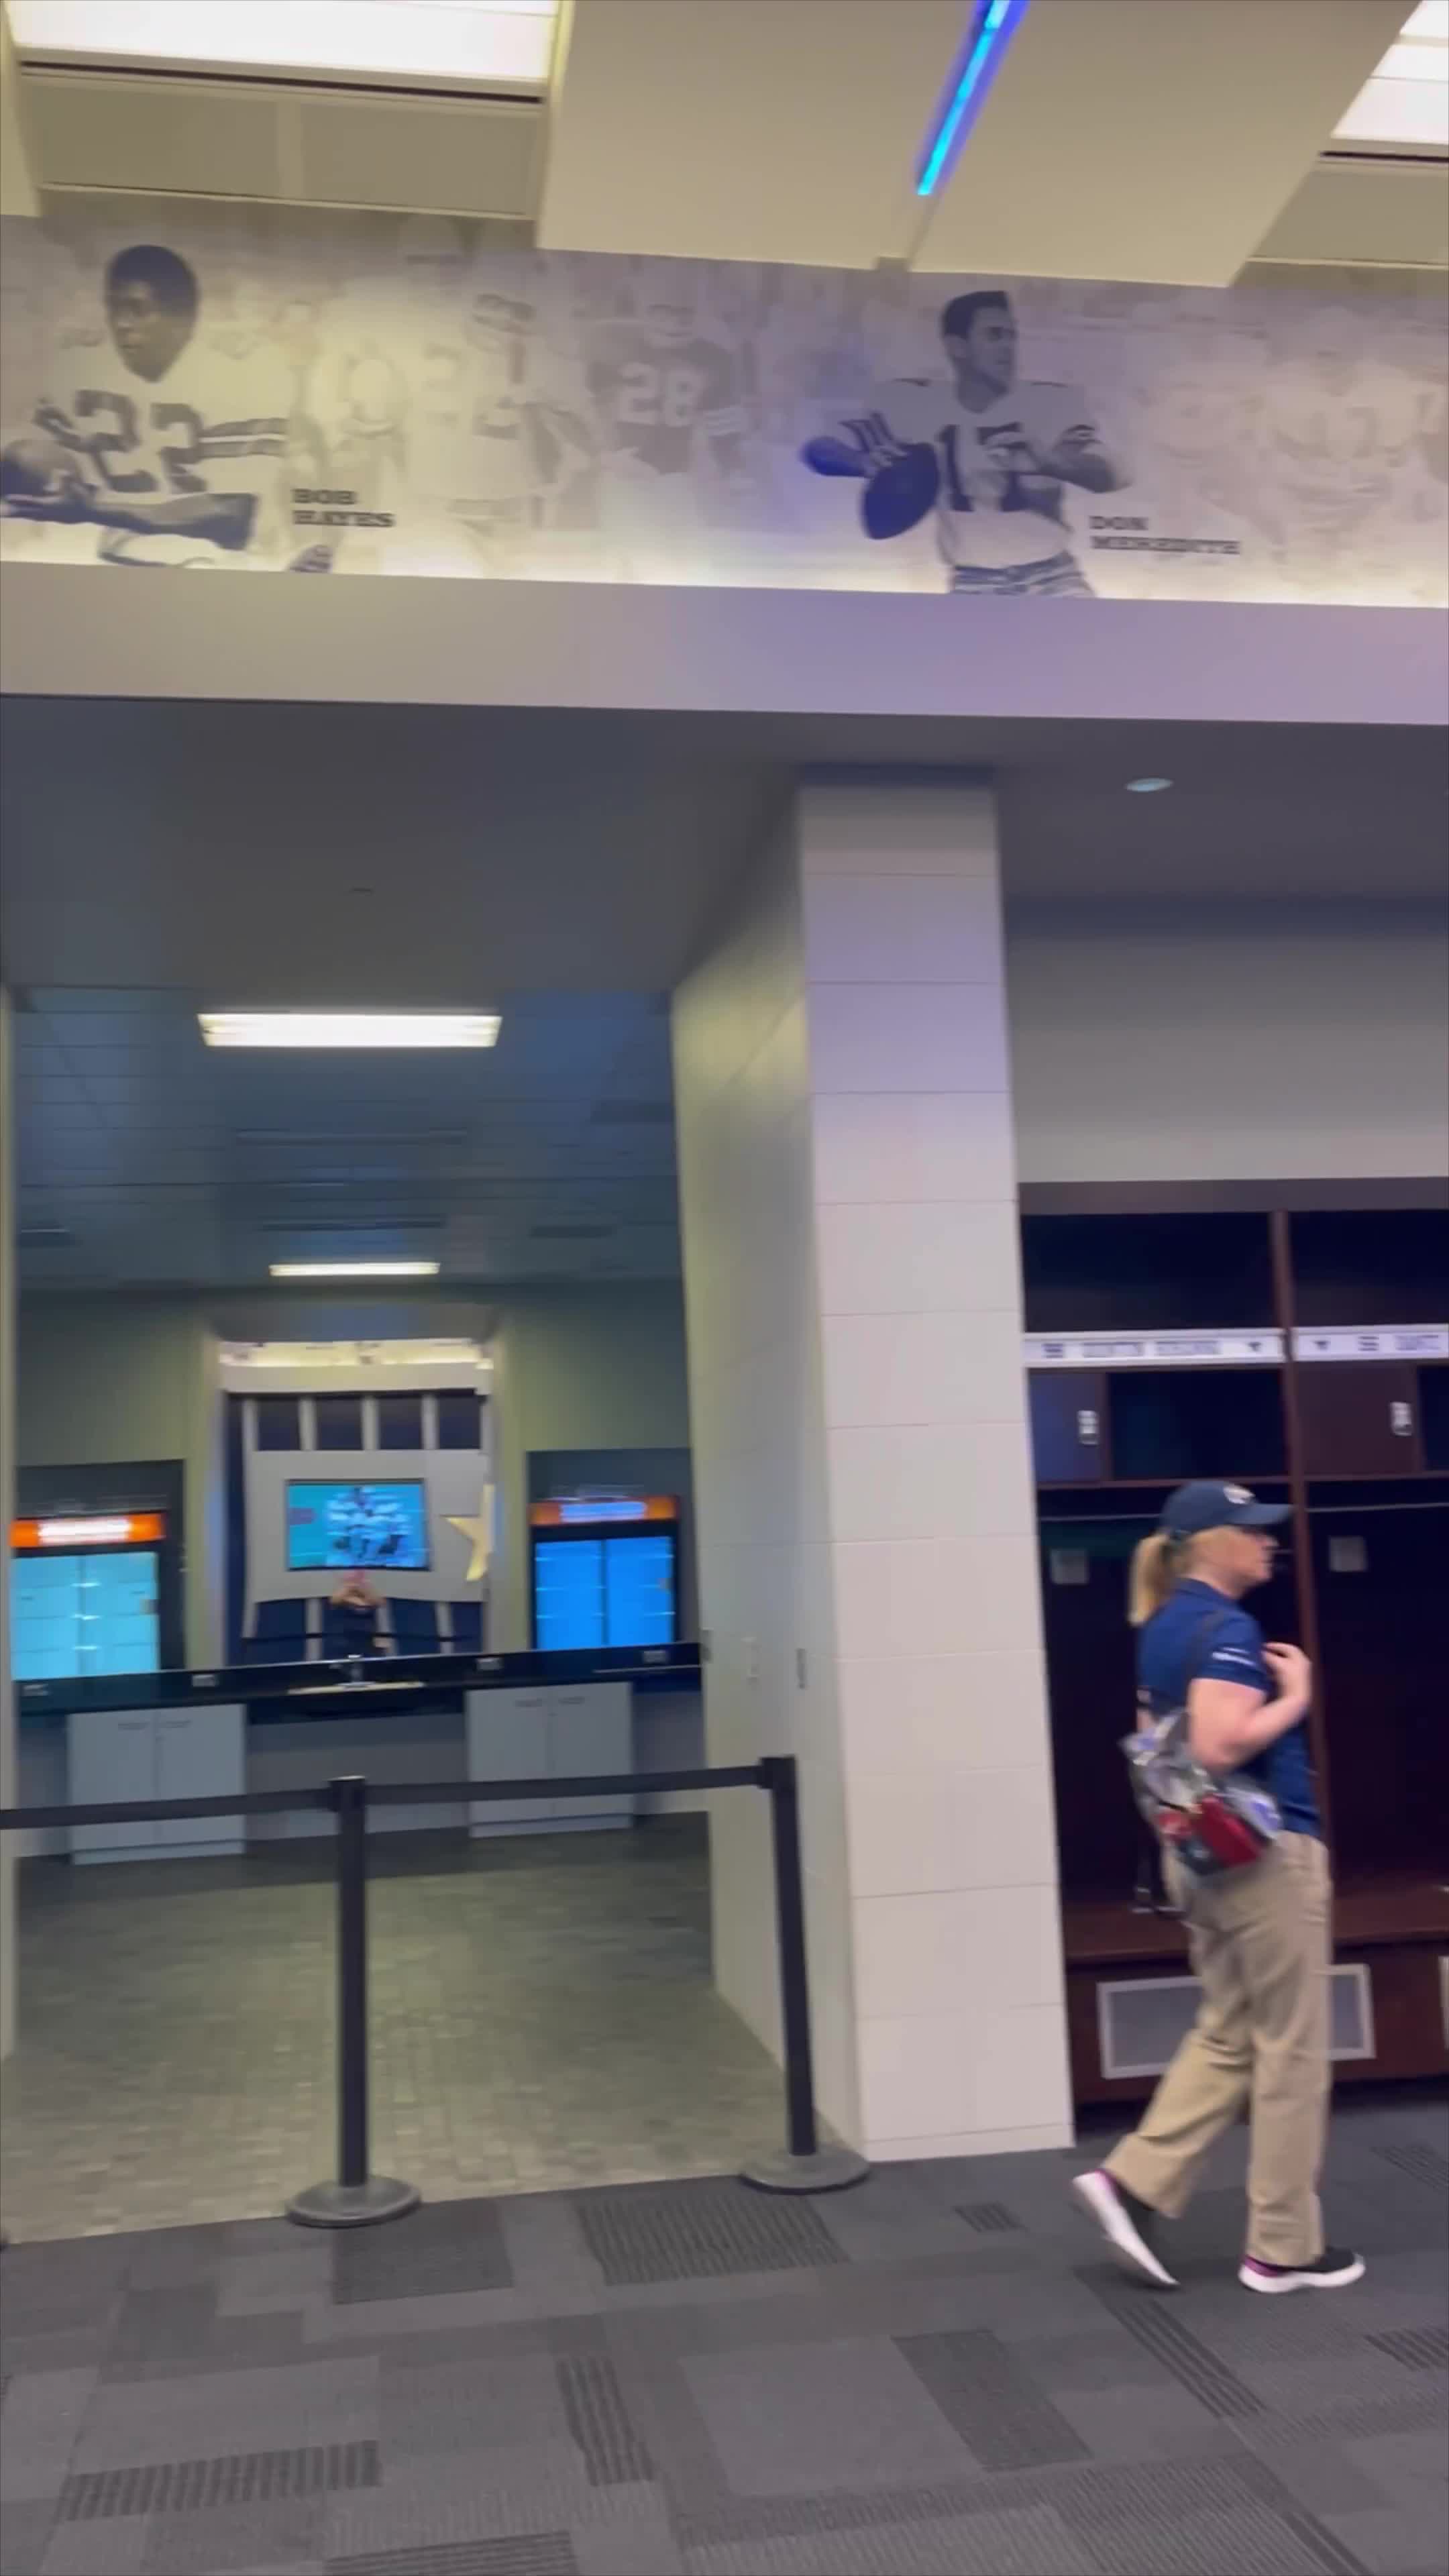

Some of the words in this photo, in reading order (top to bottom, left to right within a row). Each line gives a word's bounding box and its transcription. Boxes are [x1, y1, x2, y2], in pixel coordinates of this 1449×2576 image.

[72, 388, 208, 494] 22
[291, 488, 358, 504] BOB
[292, 510, 396, 527] HAYES
[1089, 515, 1149, 531] DON
